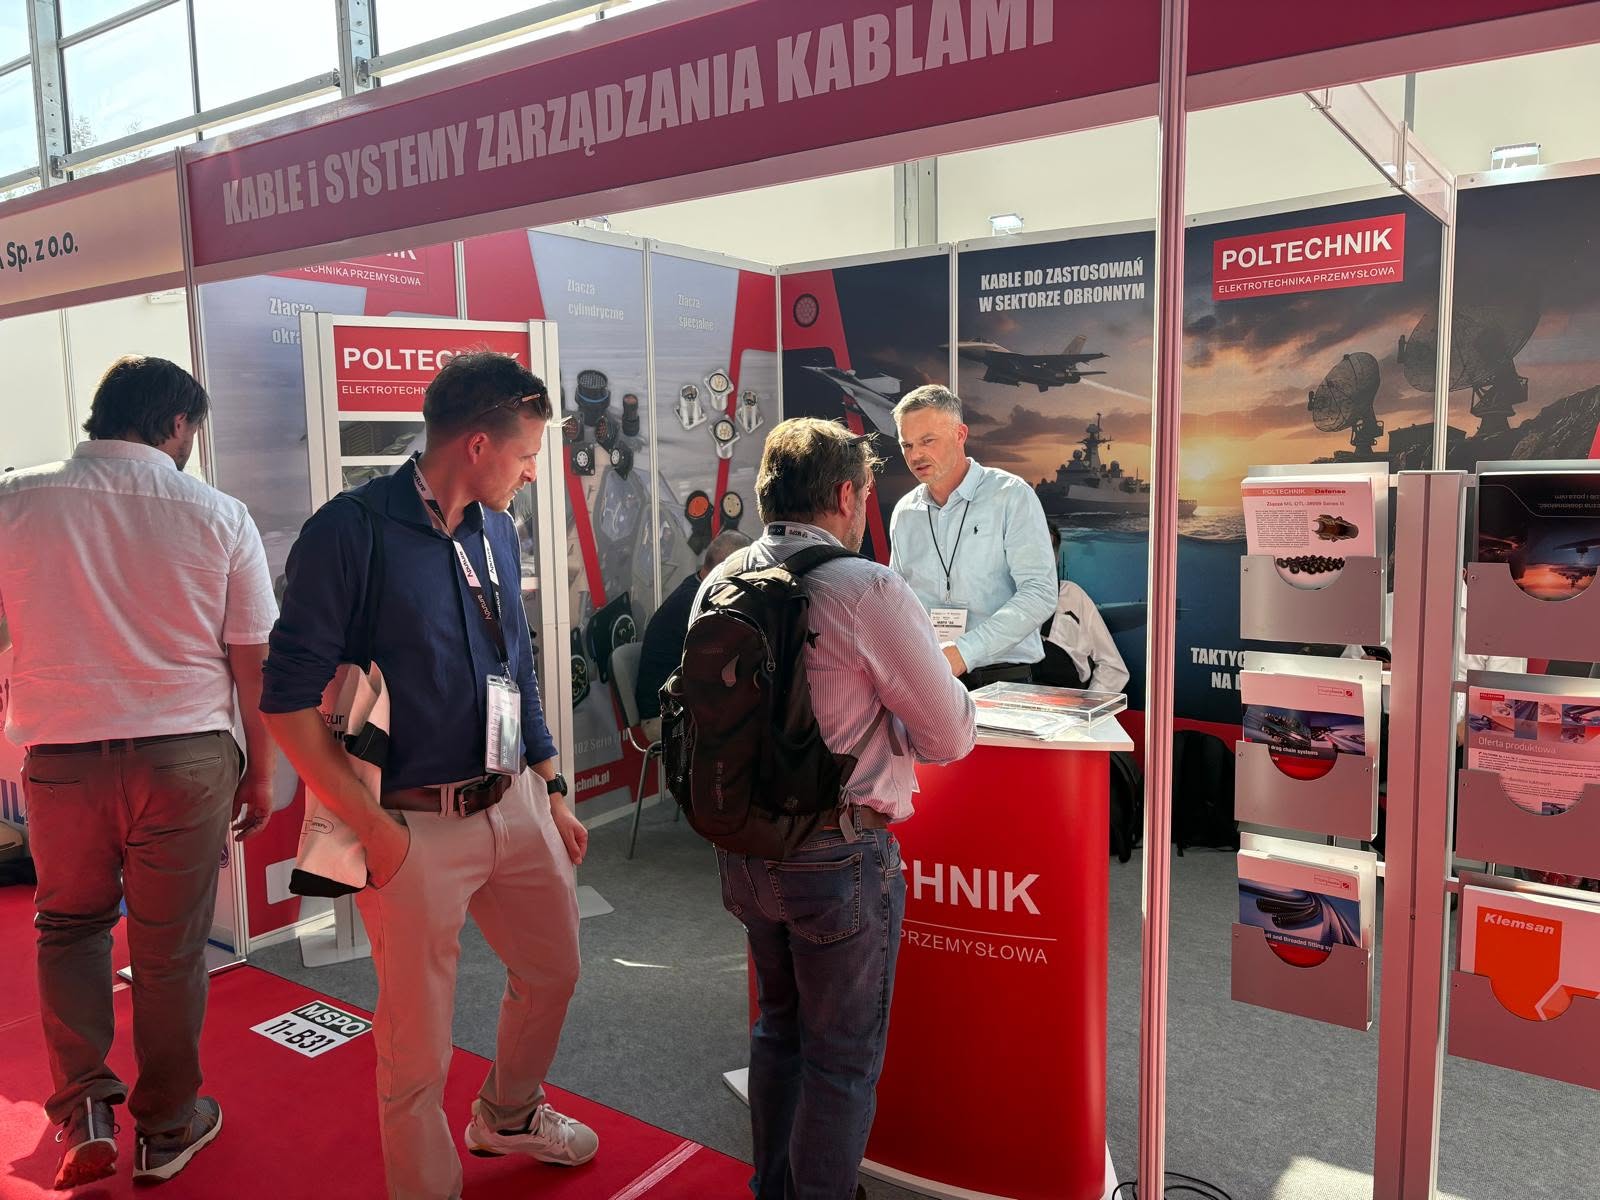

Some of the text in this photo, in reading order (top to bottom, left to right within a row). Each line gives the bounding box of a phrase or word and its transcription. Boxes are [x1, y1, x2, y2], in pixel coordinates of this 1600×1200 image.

[222, 0, 1054, 225] KABLE i SYSTEMY ZARZĄDZANIA KABLAMI
[6, 241, 32, 272] Sp.
[34, 239, 45, 261] z
[48, 231, 79, 257] o.o.
[1221, 227, 1393, 271] POLTECHNIK
[303, 264, 421, 286] ECHNIKA PRZEMYSŁOWA
[981, 257, 1144, 291] KABLE DO ZASTOSOWAŃ
[1218, 266, 1395, 293] ELEKTROTECHNIKA PRZEMYSŁOWA
[568, 303, 624, 320] cylindryczne
[979, 283, 1145, 313] W SEKTORZE OBRONNYM
[459, 551, 474, 578] Aputure
[477, 594, 493, 620] Aputure
[1211, 671, 1232, 690] NA
[1297, 748, 1319, 756] systems
[1478, 736, 1557, 754] Oferta produktowa
[901, 859, 1041, 915] HNIK
[1484, 912, 1555, 935] Klemsan
[1283, 936, 1307, 946] threaded
[297, 1004, 367, 1034] MSPO
[263, 1019, 337, 1053] 11-B31
